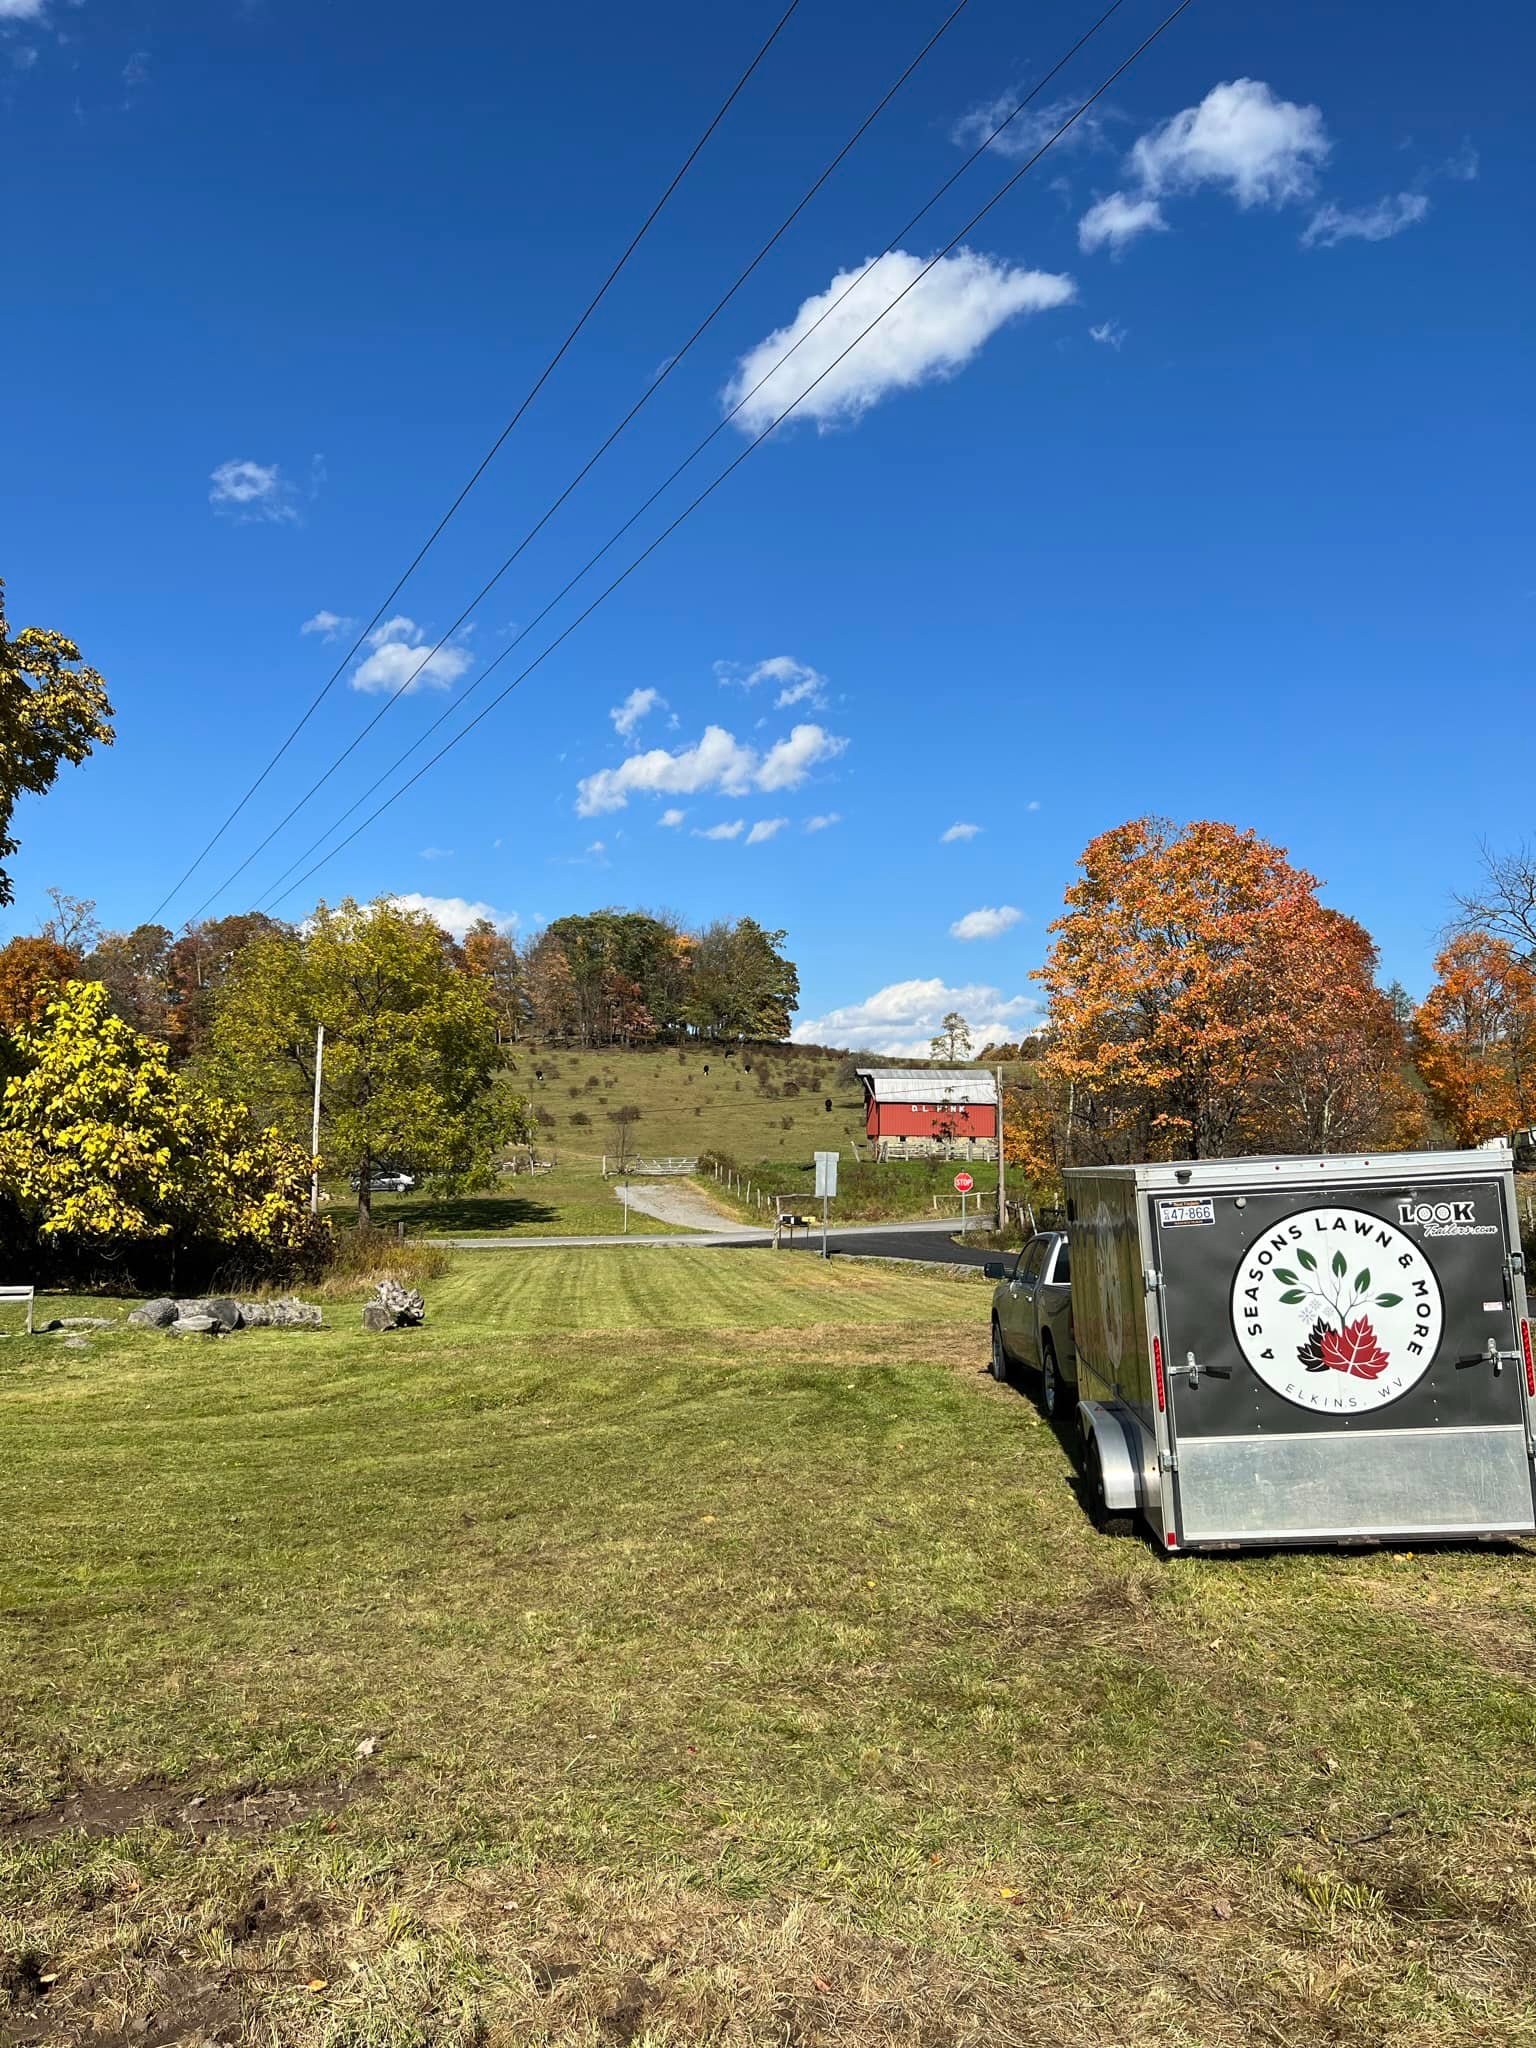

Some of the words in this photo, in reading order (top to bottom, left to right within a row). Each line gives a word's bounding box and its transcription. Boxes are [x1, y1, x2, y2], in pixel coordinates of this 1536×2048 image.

[956, 1178, 972, 1187] STOP
[1399, 1202, 1475, 1224] LOOK
[1315, 1217, 1393, 1248] LAWN
[1423, 1223, 1498, 1237] Trailers.com
[1398, 1253, 1413, 1269] &
[1244, 1225, 1303, 1336] SEASONS
[1407, 1280, 1431, 1356] MORE
[1260, 1348, 1274, 1360] 4
[1377, 1377, 1403, 1398] WV
